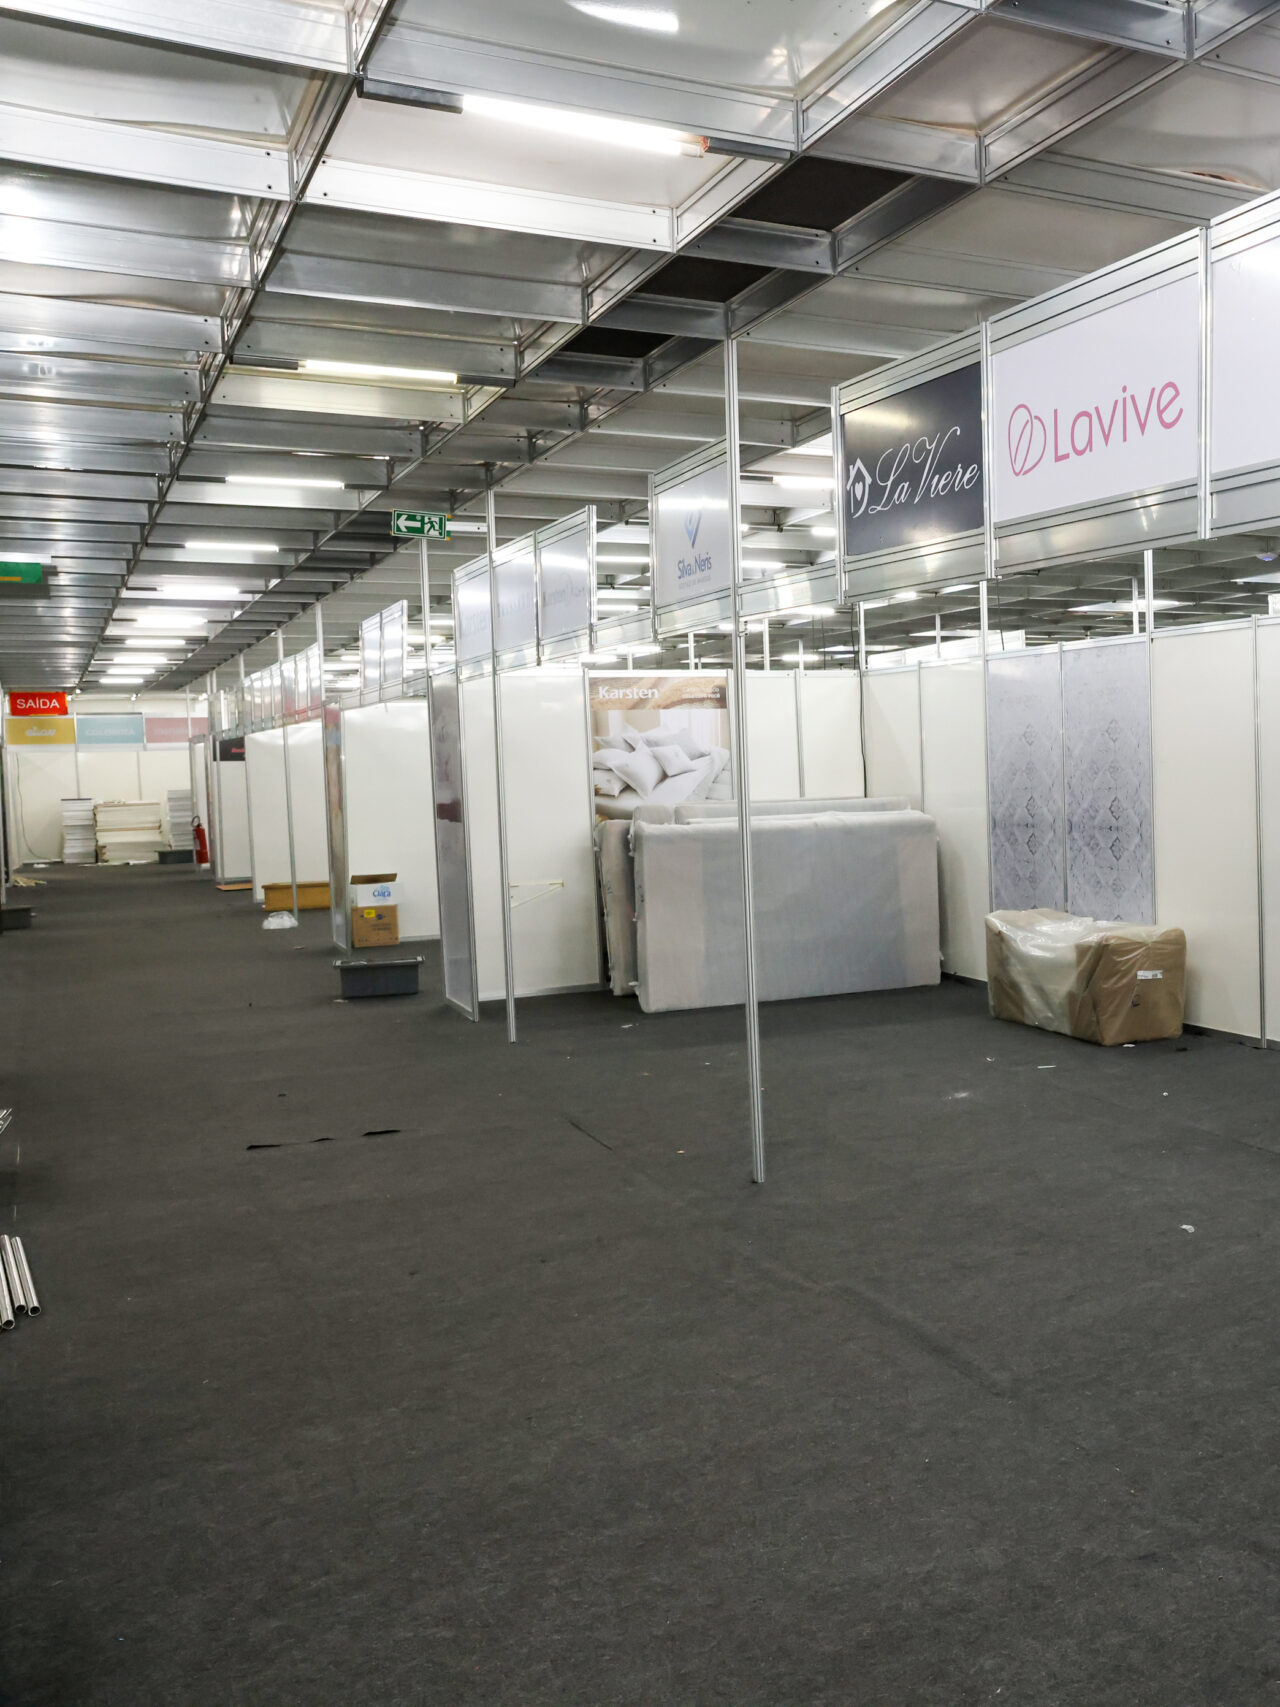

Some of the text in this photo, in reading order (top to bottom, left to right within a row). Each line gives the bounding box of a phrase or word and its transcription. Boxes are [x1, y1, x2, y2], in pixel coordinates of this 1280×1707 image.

[1053, 381, 1184, 463] Lavive
[868, 443, 912, 514] La
[16, 697, 60, 709] SAÍDA
[598, 686, 659, 700] Karsten
